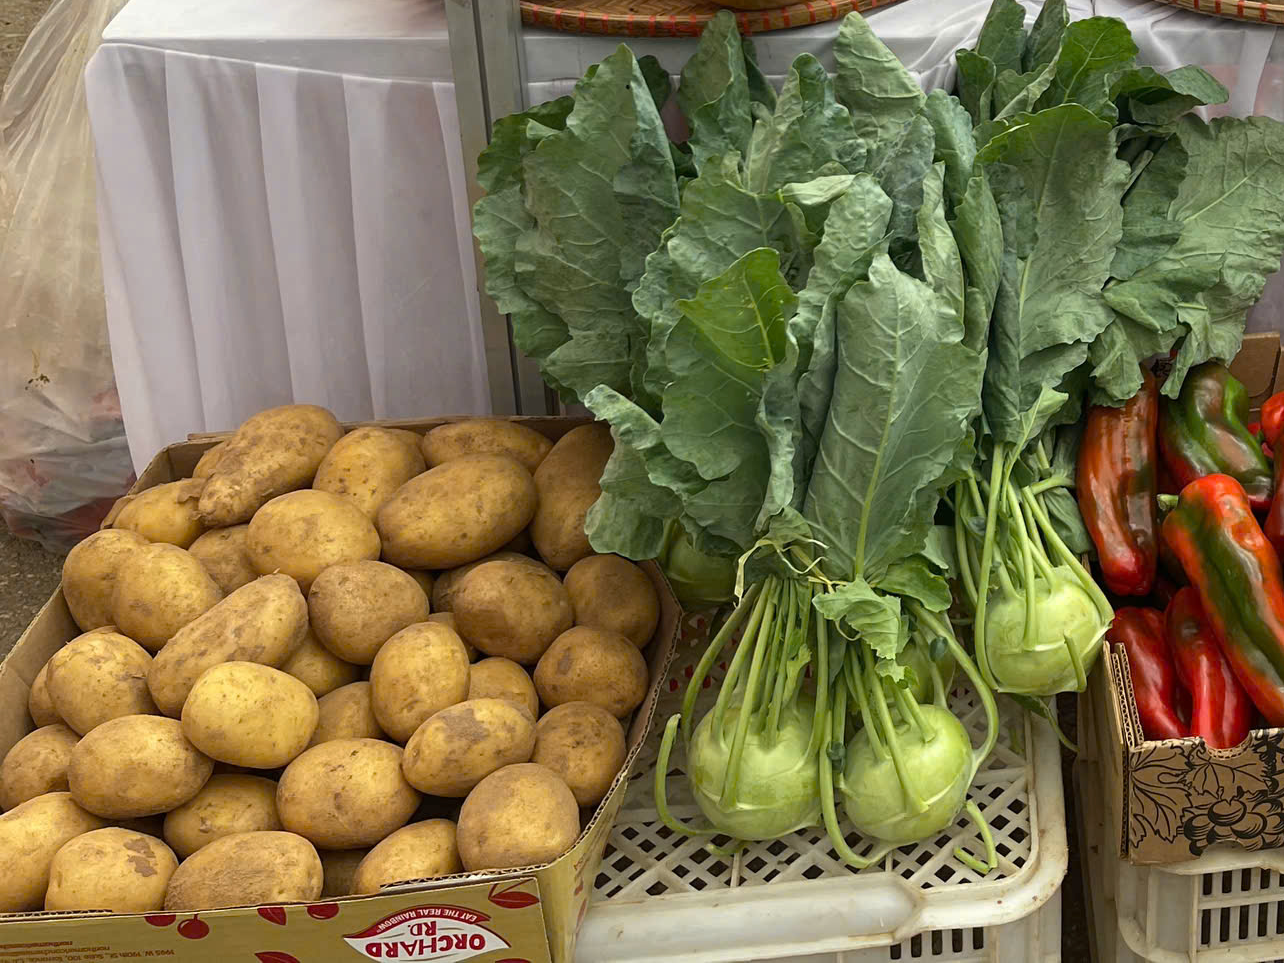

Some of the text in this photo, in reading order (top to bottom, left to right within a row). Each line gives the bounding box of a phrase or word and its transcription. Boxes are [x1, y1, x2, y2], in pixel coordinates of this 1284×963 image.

[417, 908, 442, 917] REAL
[442, 909, 460, 918] THE
[461, 912, 478, 922] EAT
[407, 921, 437, 937] RD.
[365, 933, 486, 958] ORCHARD
